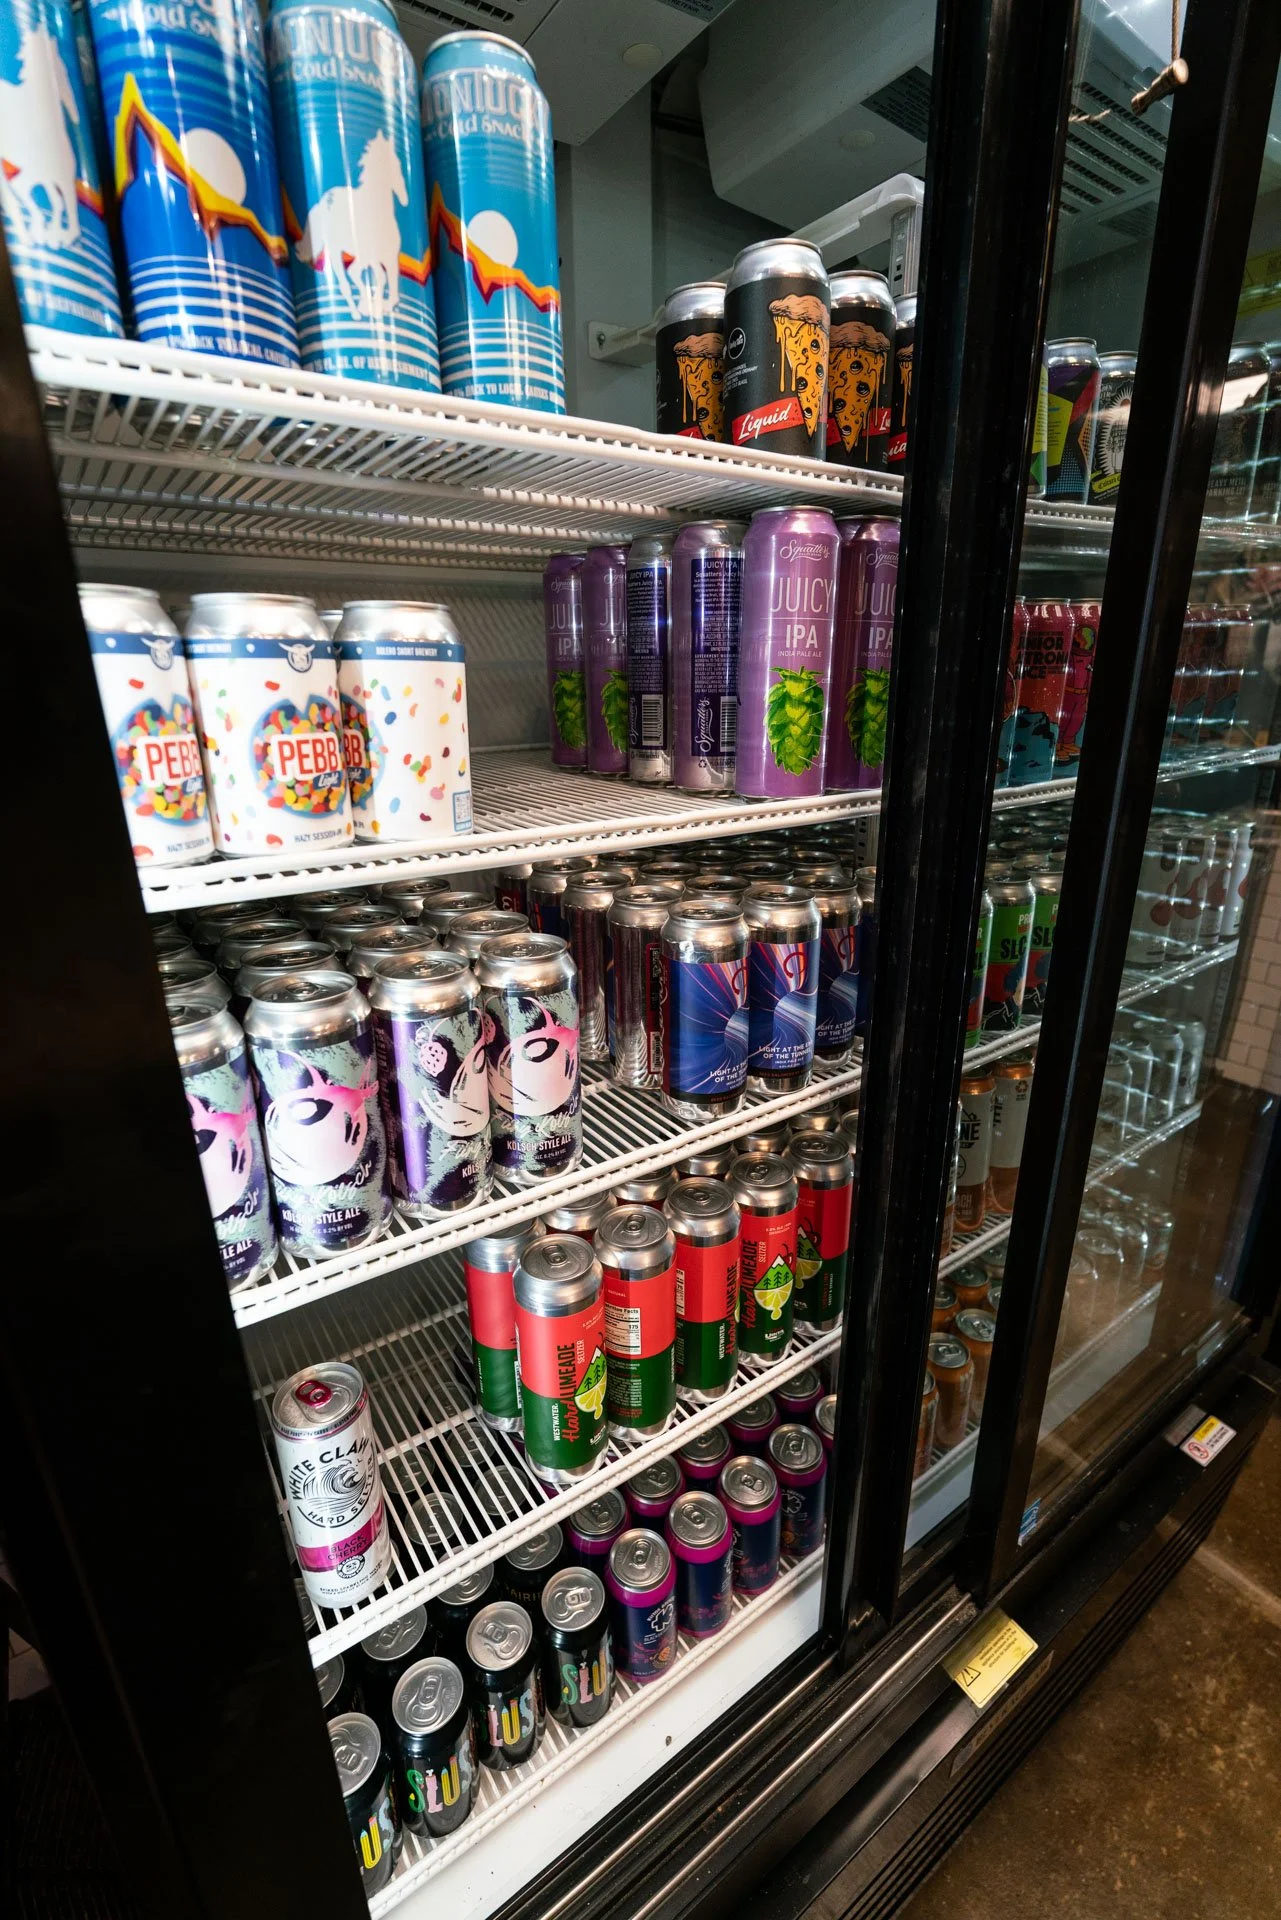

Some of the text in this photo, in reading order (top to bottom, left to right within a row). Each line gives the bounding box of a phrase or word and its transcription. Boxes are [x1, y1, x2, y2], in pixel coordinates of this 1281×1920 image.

[738, 403, 790, 440] Liquid
[770, 577, 833, 613] JUICY
[785, 624, 818, 649] IPA
[278, 737, 339, 776] PEBB
[710, 1068, 730, 1077] LIGHT
[727, 1073, 738, 1081] THE
[506, 1133, 572, 1152] KÖLSCH STYLE ALE
[317, 1211, 343, 1224] STYLE
[345, 1206, 361, 1219] ALE
[742, 1239, 757, 1289] LIMEADE
[741, 1286, 756, 1329] Hard
[557, 1343, 576, 1400] LIMEADE
[560, 1397, 580, 1443] Hard
[289, 1437, 369, 1500] WHITE CLAW
[308, 1511, 345, 1524] HARD
[328, 1538, 367, 1560] CHERRY
[331, 1535, 365, 1553] BLACK
